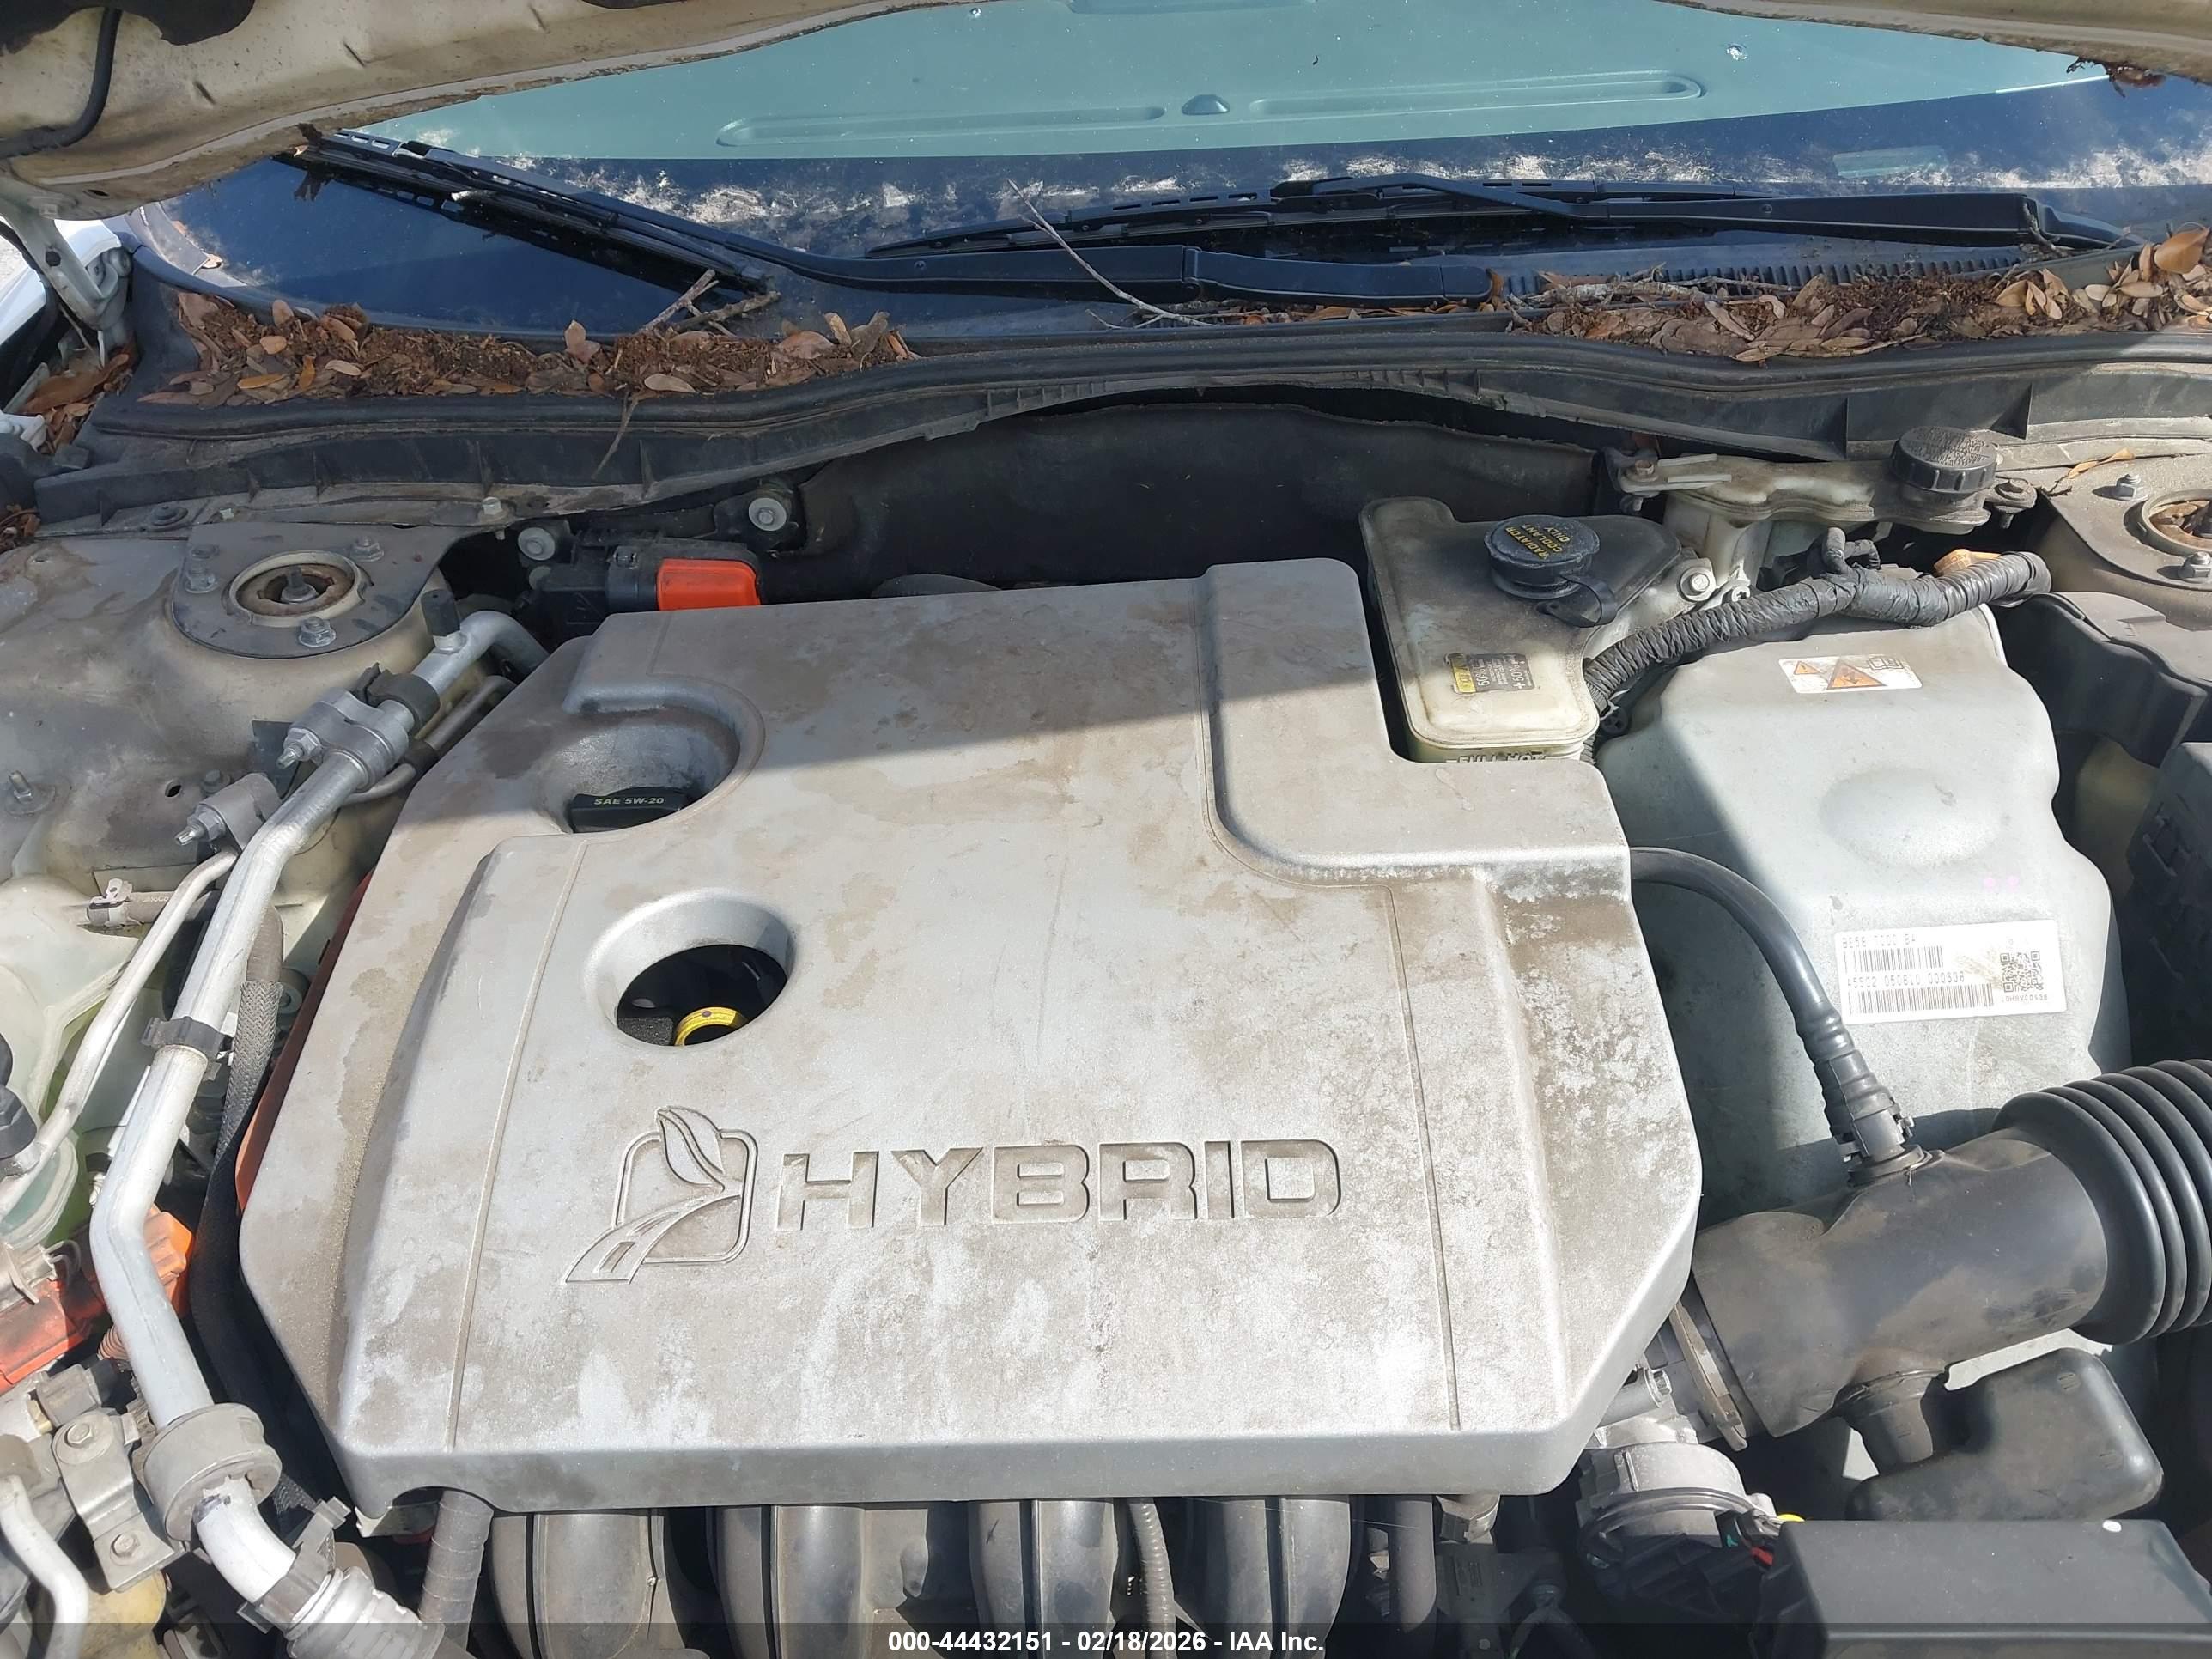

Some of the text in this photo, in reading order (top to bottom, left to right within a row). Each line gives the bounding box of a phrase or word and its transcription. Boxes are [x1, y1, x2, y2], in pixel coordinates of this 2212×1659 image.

[1505, 526, 1549, 559] RADIATOR
[1520, 524, 1563, 552] COOLANT
[1544, 526, 1571, 542] ONLY
[593, 797, 665, 806] SAE 5W-20
[776, 1139, 1342, 1231] HYBRID
